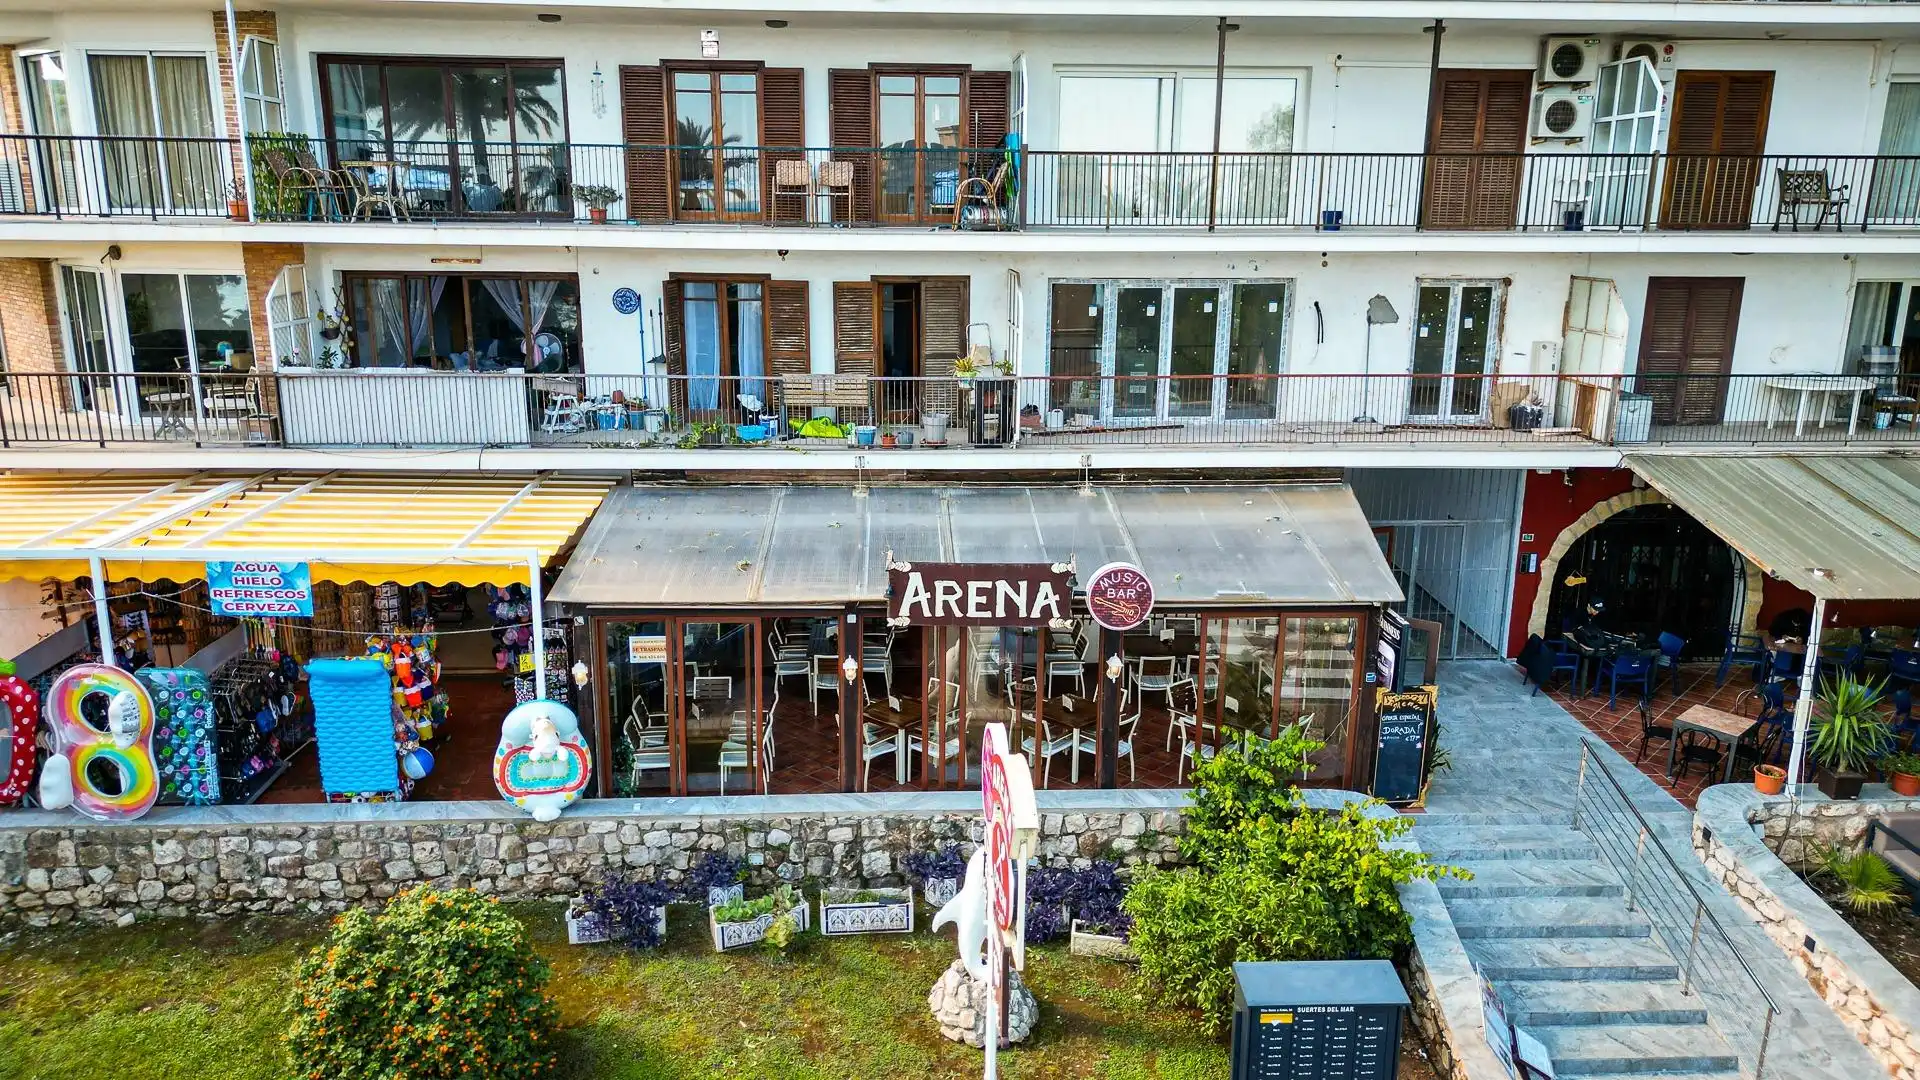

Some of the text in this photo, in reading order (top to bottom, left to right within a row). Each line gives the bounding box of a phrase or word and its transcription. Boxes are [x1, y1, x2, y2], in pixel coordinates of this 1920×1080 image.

[233, 563, 280, 573] AGUA
[234, 576, 282, 586] HIELO
[1099, 572, 1148, 592] MUSIC
[212, 589, 306, 599] REFRESCOS
[898, 571, 1061, 619] ARENA
[1107, 587, 1136, 599] BAR
[223, 602, 298, 612] CERVEZA
